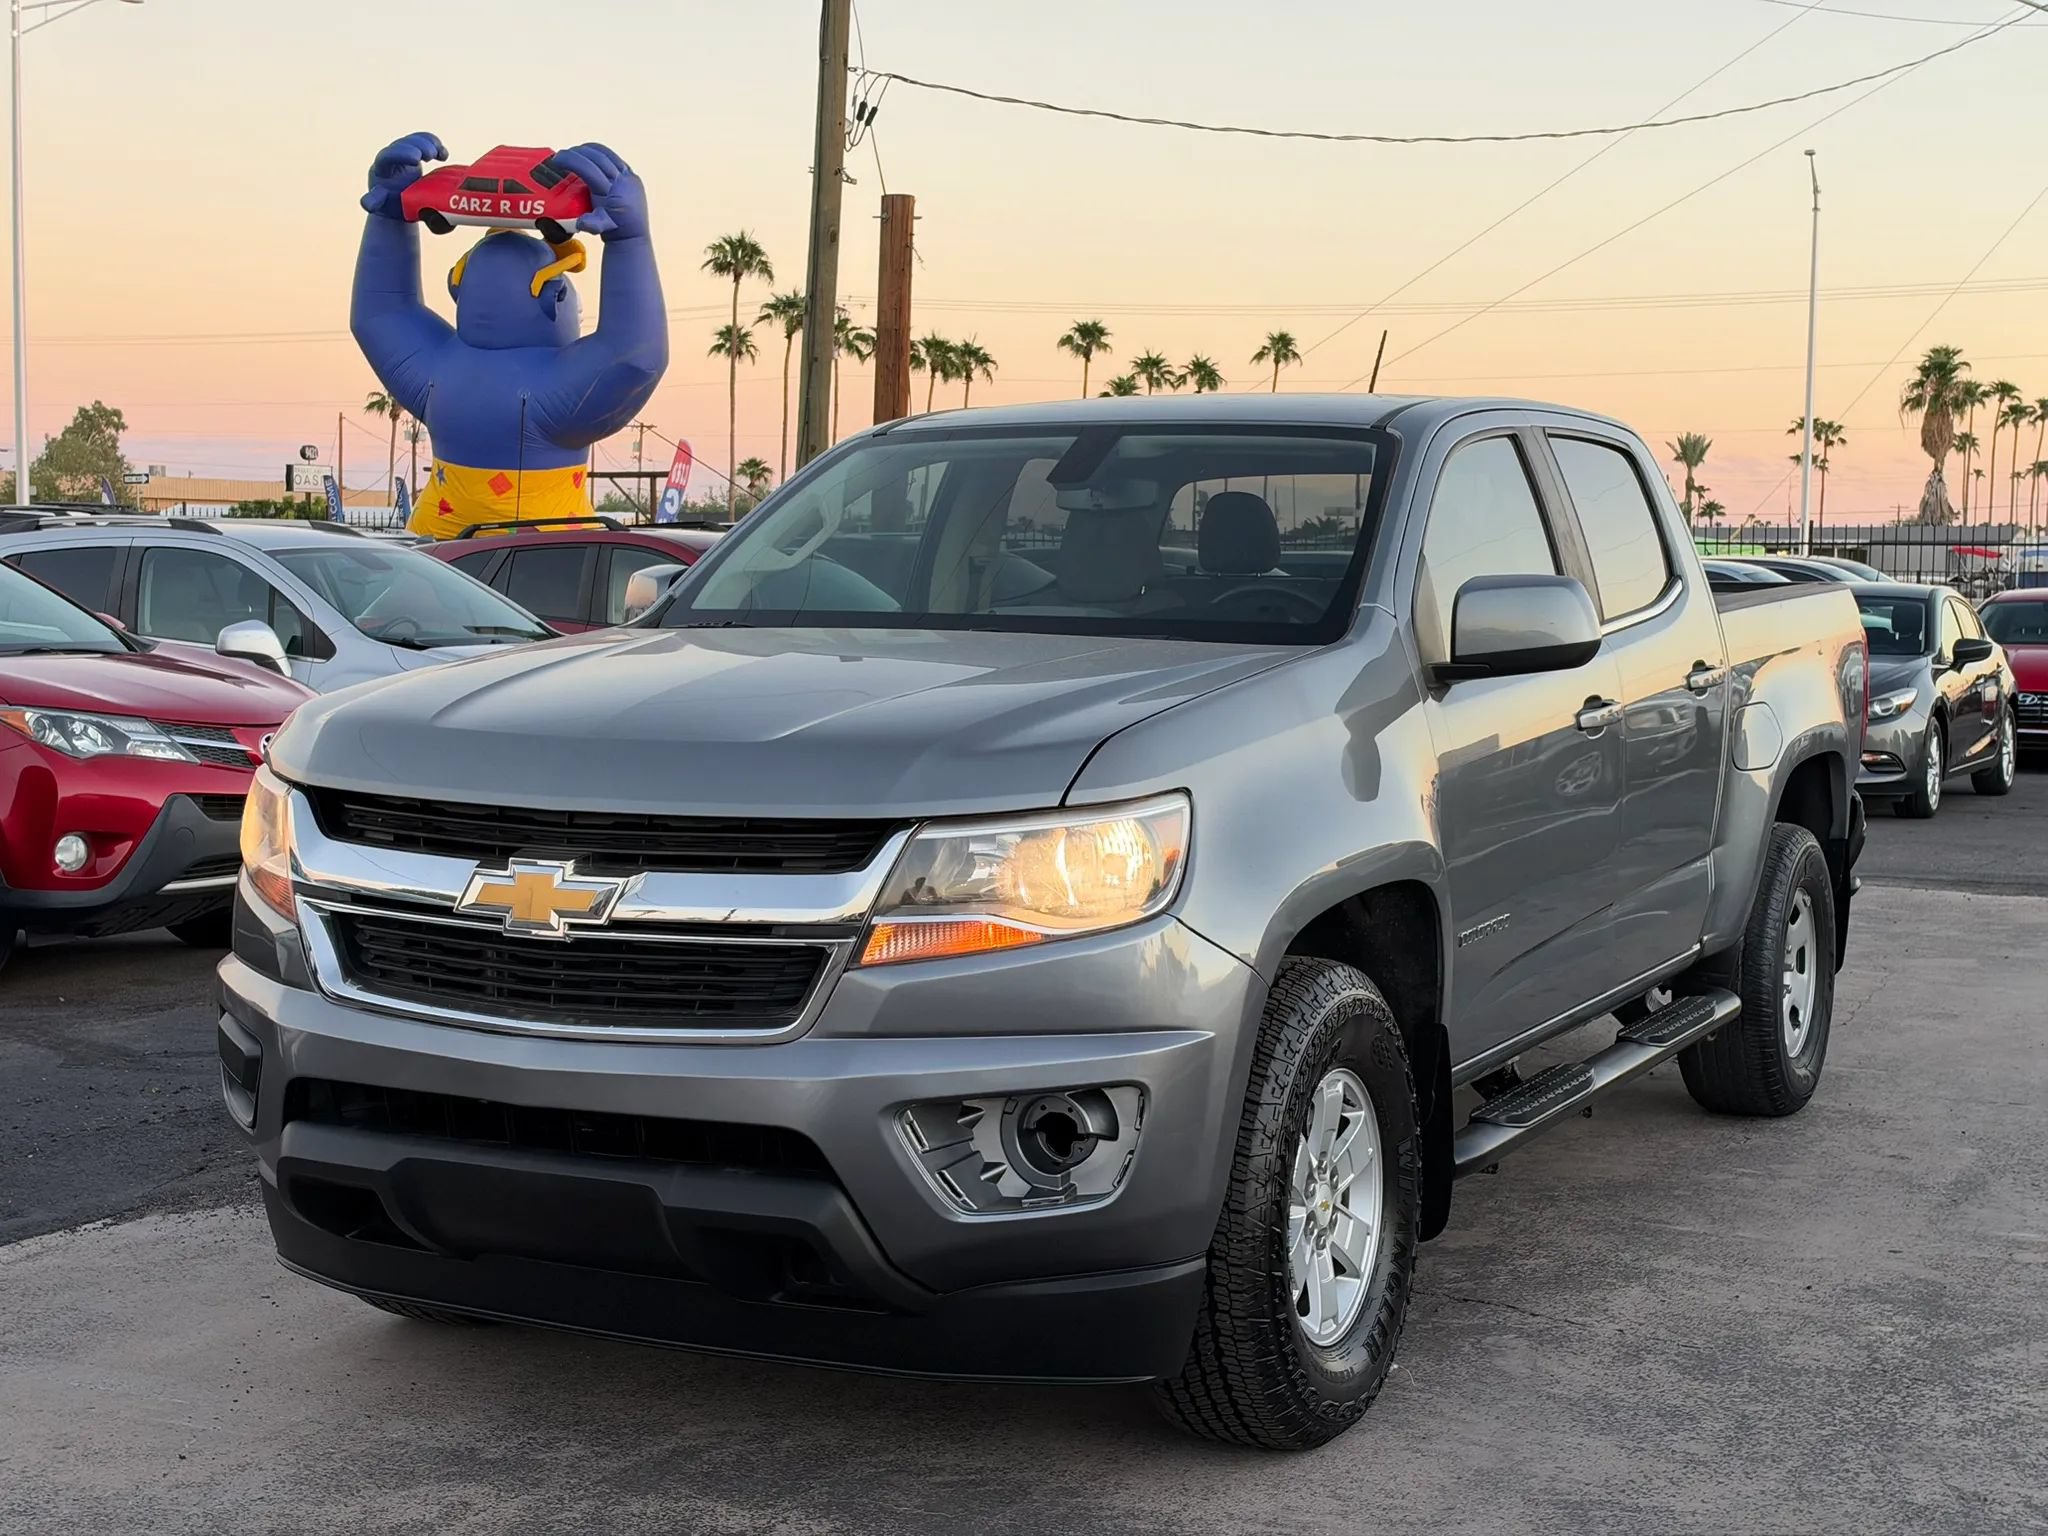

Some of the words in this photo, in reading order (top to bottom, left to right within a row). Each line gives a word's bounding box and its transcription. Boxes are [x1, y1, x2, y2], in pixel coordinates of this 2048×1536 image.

[449, 194, 492, 213] CARZ
[500, 199, 511, 214] R
[519, 200, 545, 215] US
[294, 474, 324, 487] OASI
